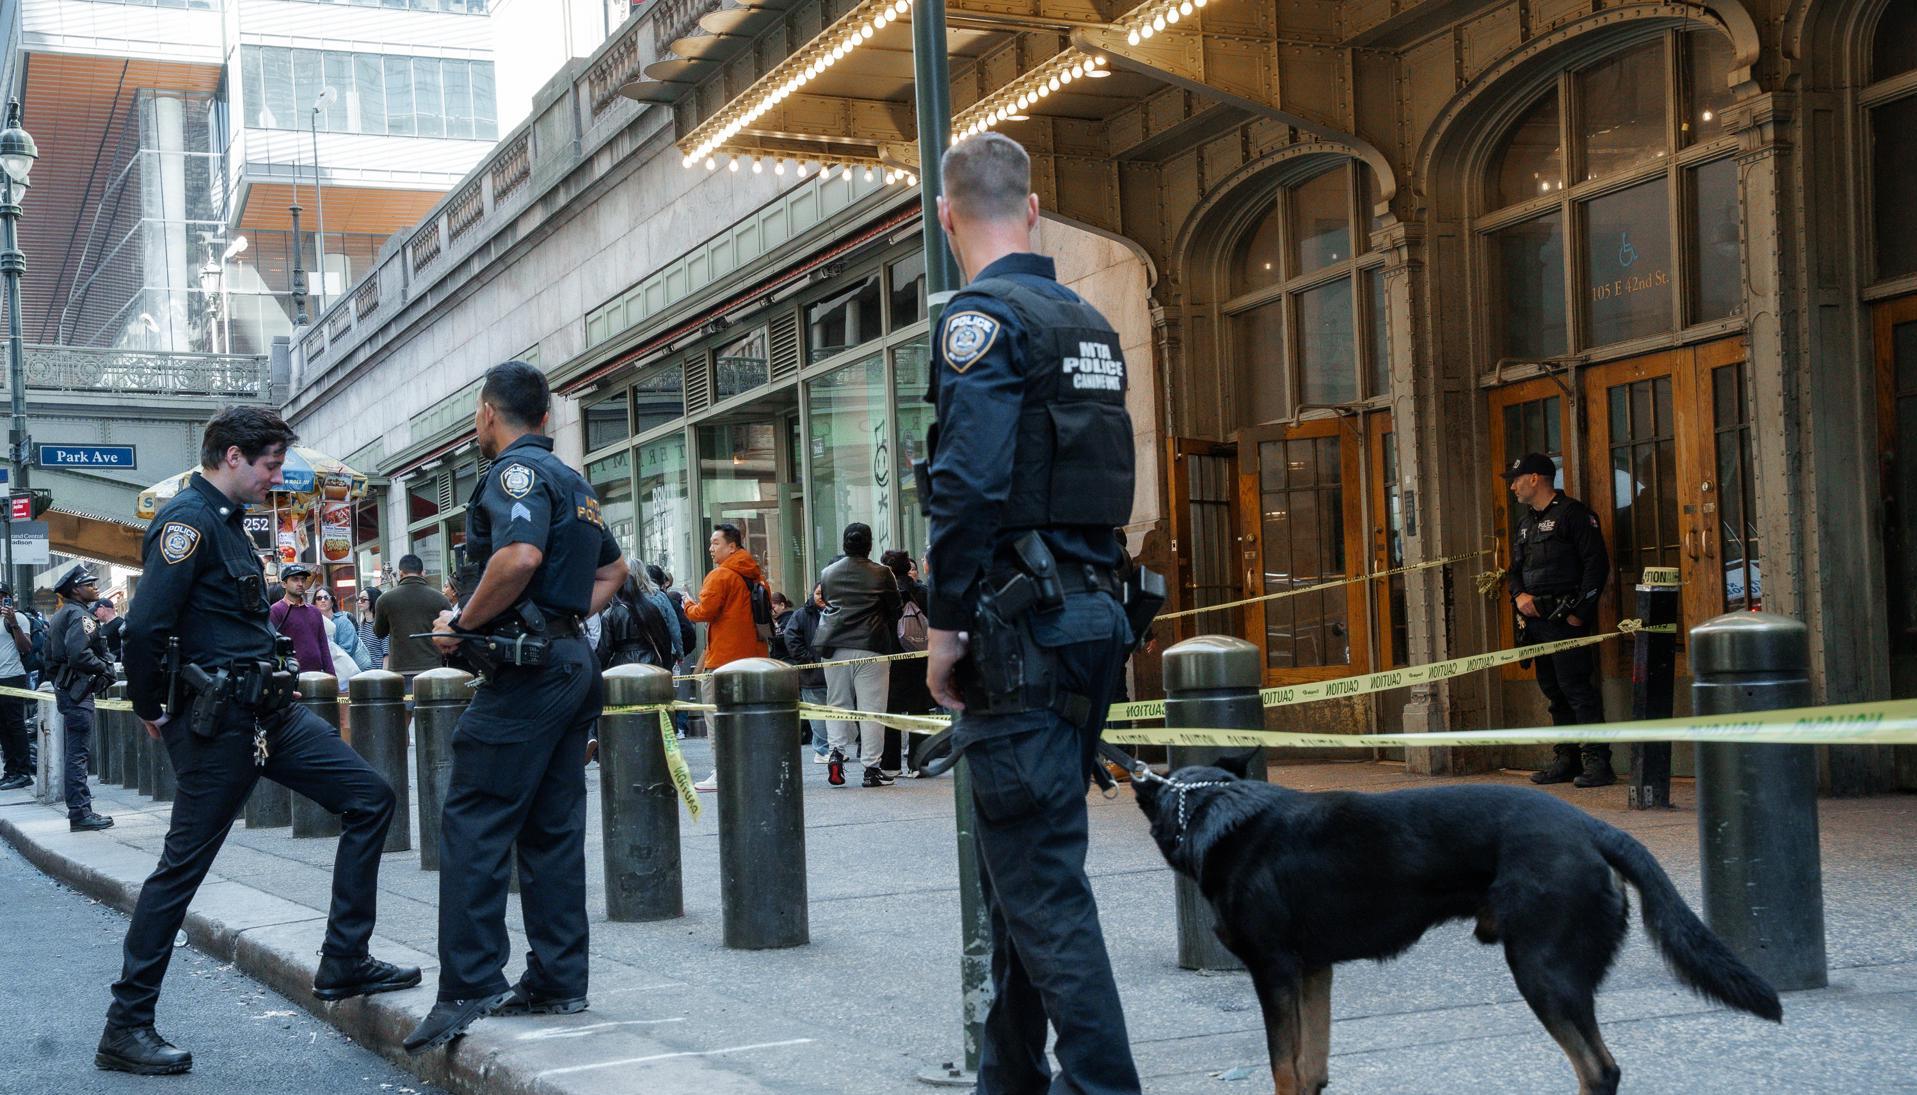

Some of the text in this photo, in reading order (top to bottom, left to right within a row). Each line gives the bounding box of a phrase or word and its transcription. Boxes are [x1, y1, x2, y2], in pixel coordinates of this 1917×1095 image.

[1592, 270, 1670, 301] 105 E 42nd St.
[949, 315, 993, 333] POLICE
[1079, 341, 1111, 360] MTA
[1063, 357, 1124, 377] POLICE
[57, 450, 119, 463] Park Ave
[505, 466, 530, 479] POLICE
[243, 518, 269, 531] 252
[167, 525, 198, 542] POLICE
